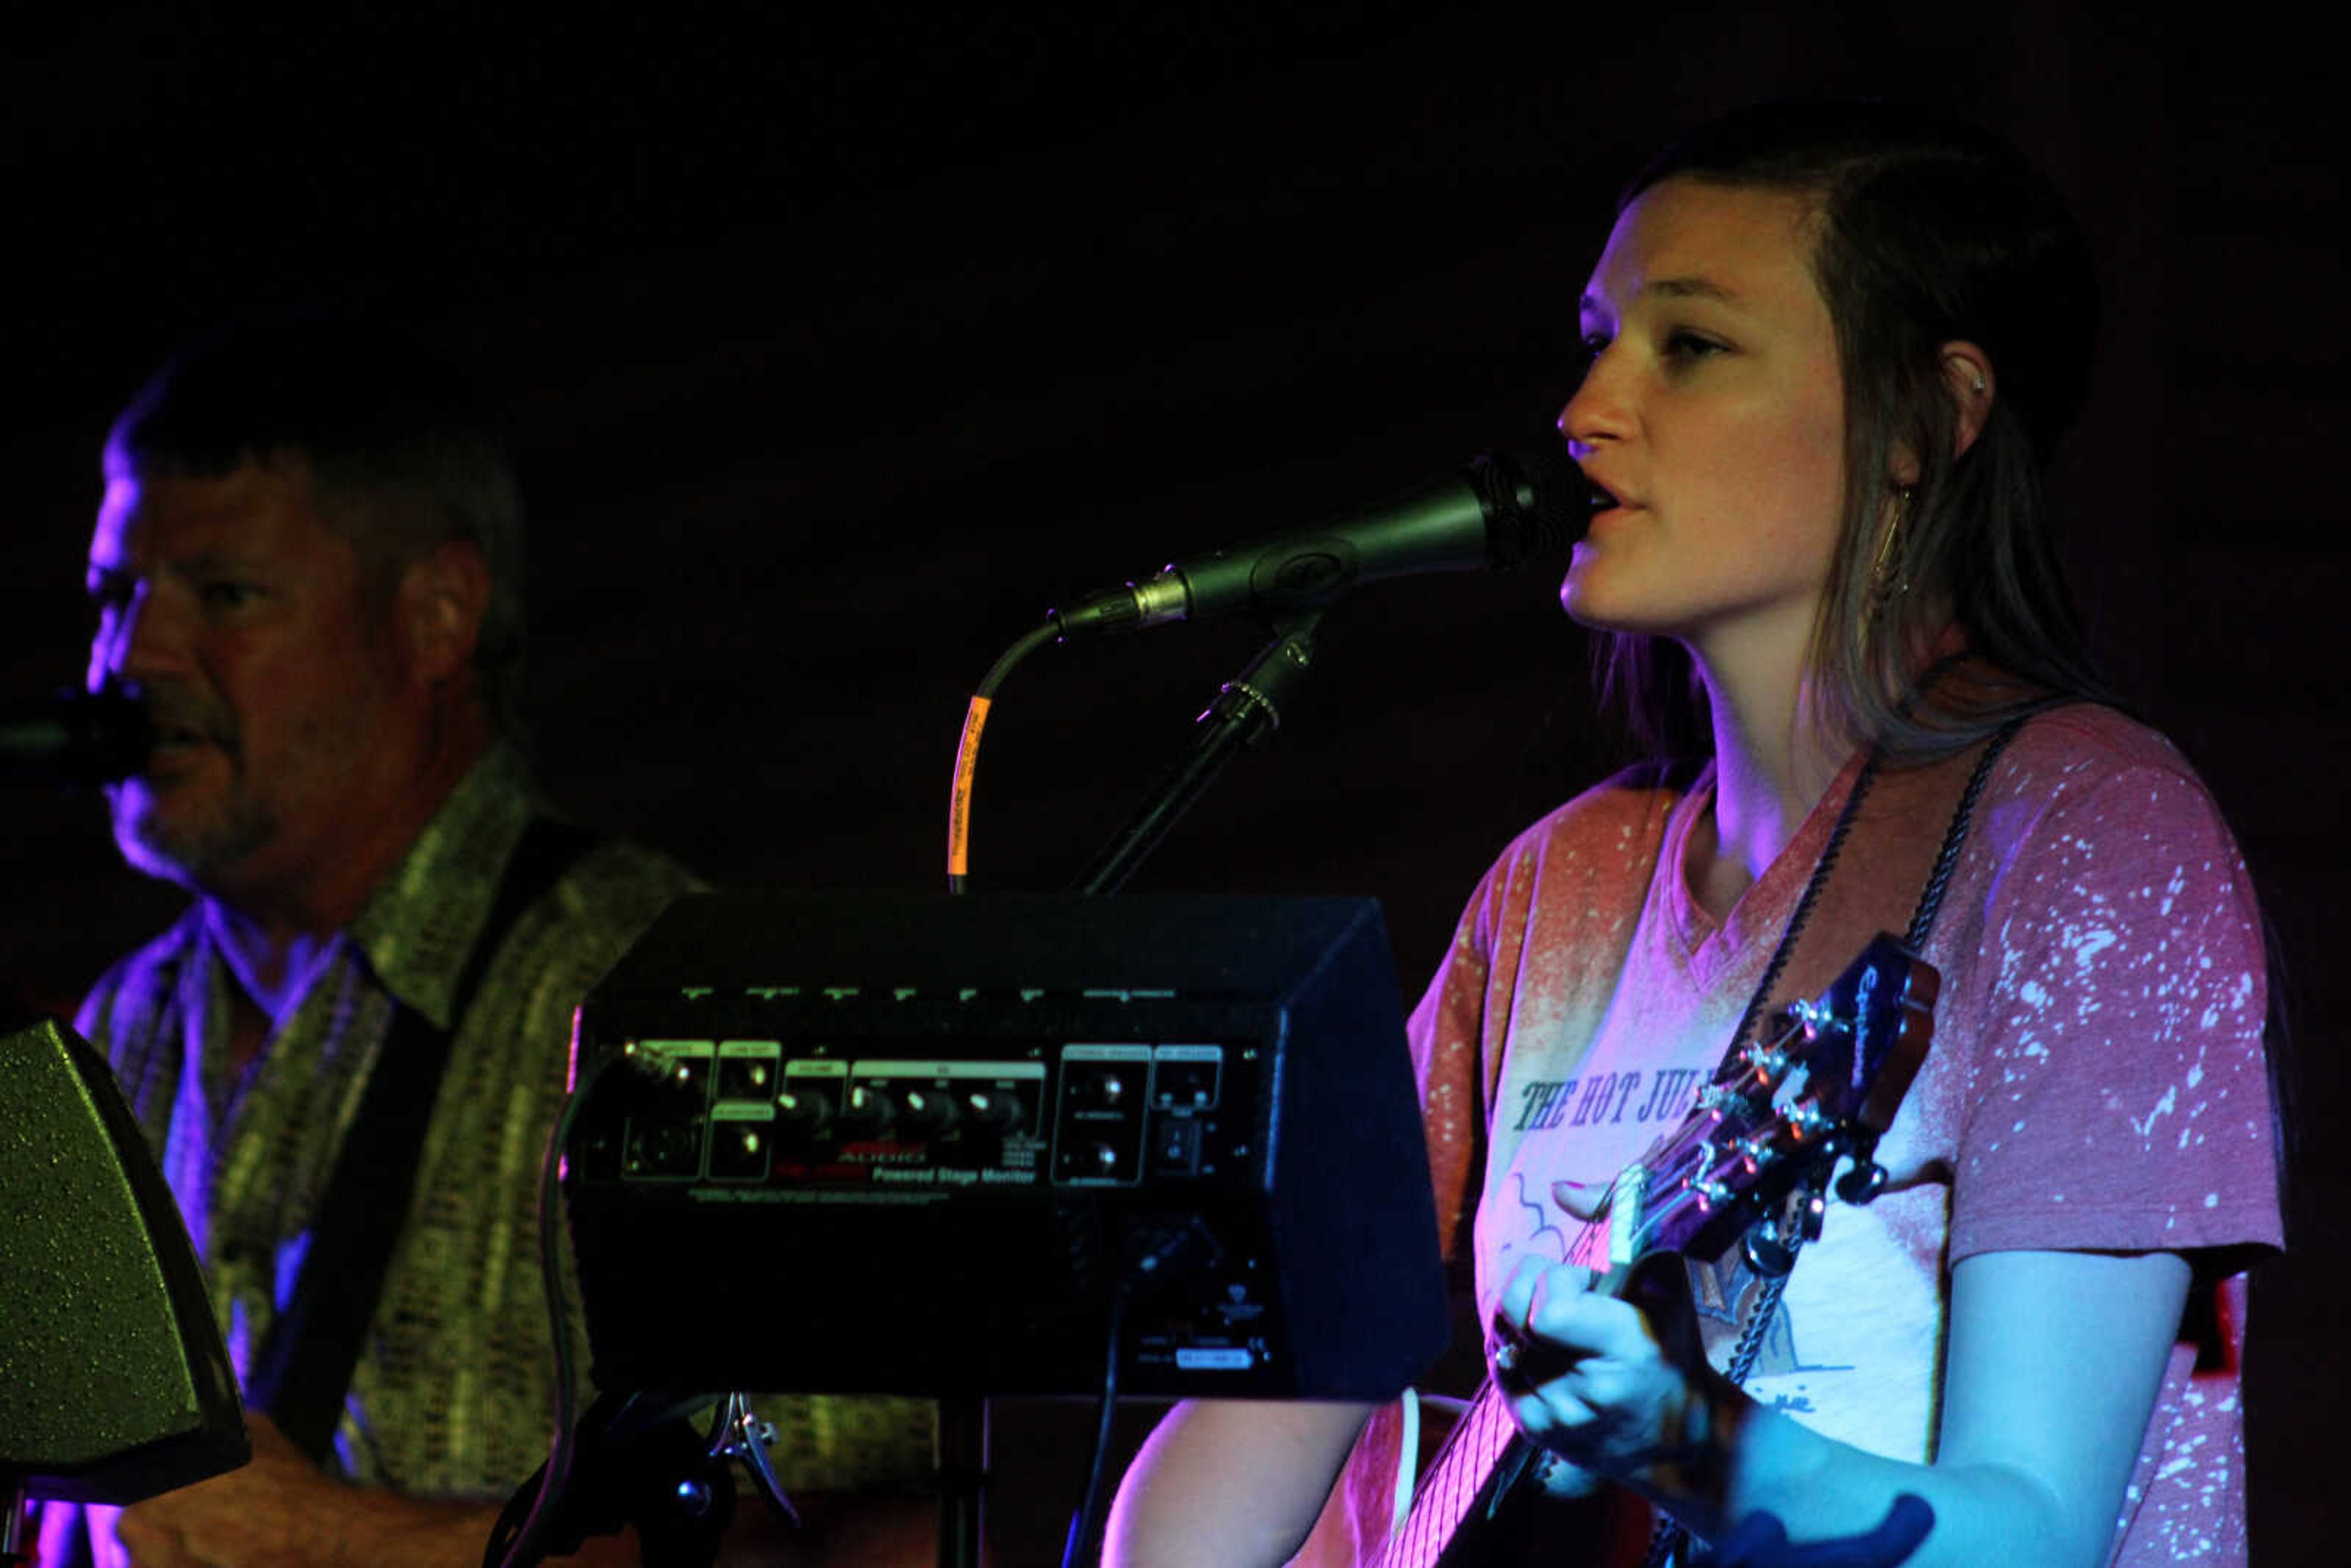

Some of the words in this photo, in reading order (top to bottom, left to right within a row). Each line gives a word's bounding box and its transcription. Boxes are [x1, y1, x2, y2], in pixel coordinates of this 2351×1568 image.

[1513, 1080, 1578, 1131] THE
[1571, 1071, 1641, 1127] HOT
[872, 1165, 934, 1183] Powered
[937, 1165, 978, 1187] Stage
[981, 1165, 1036, 1184] Monitor
